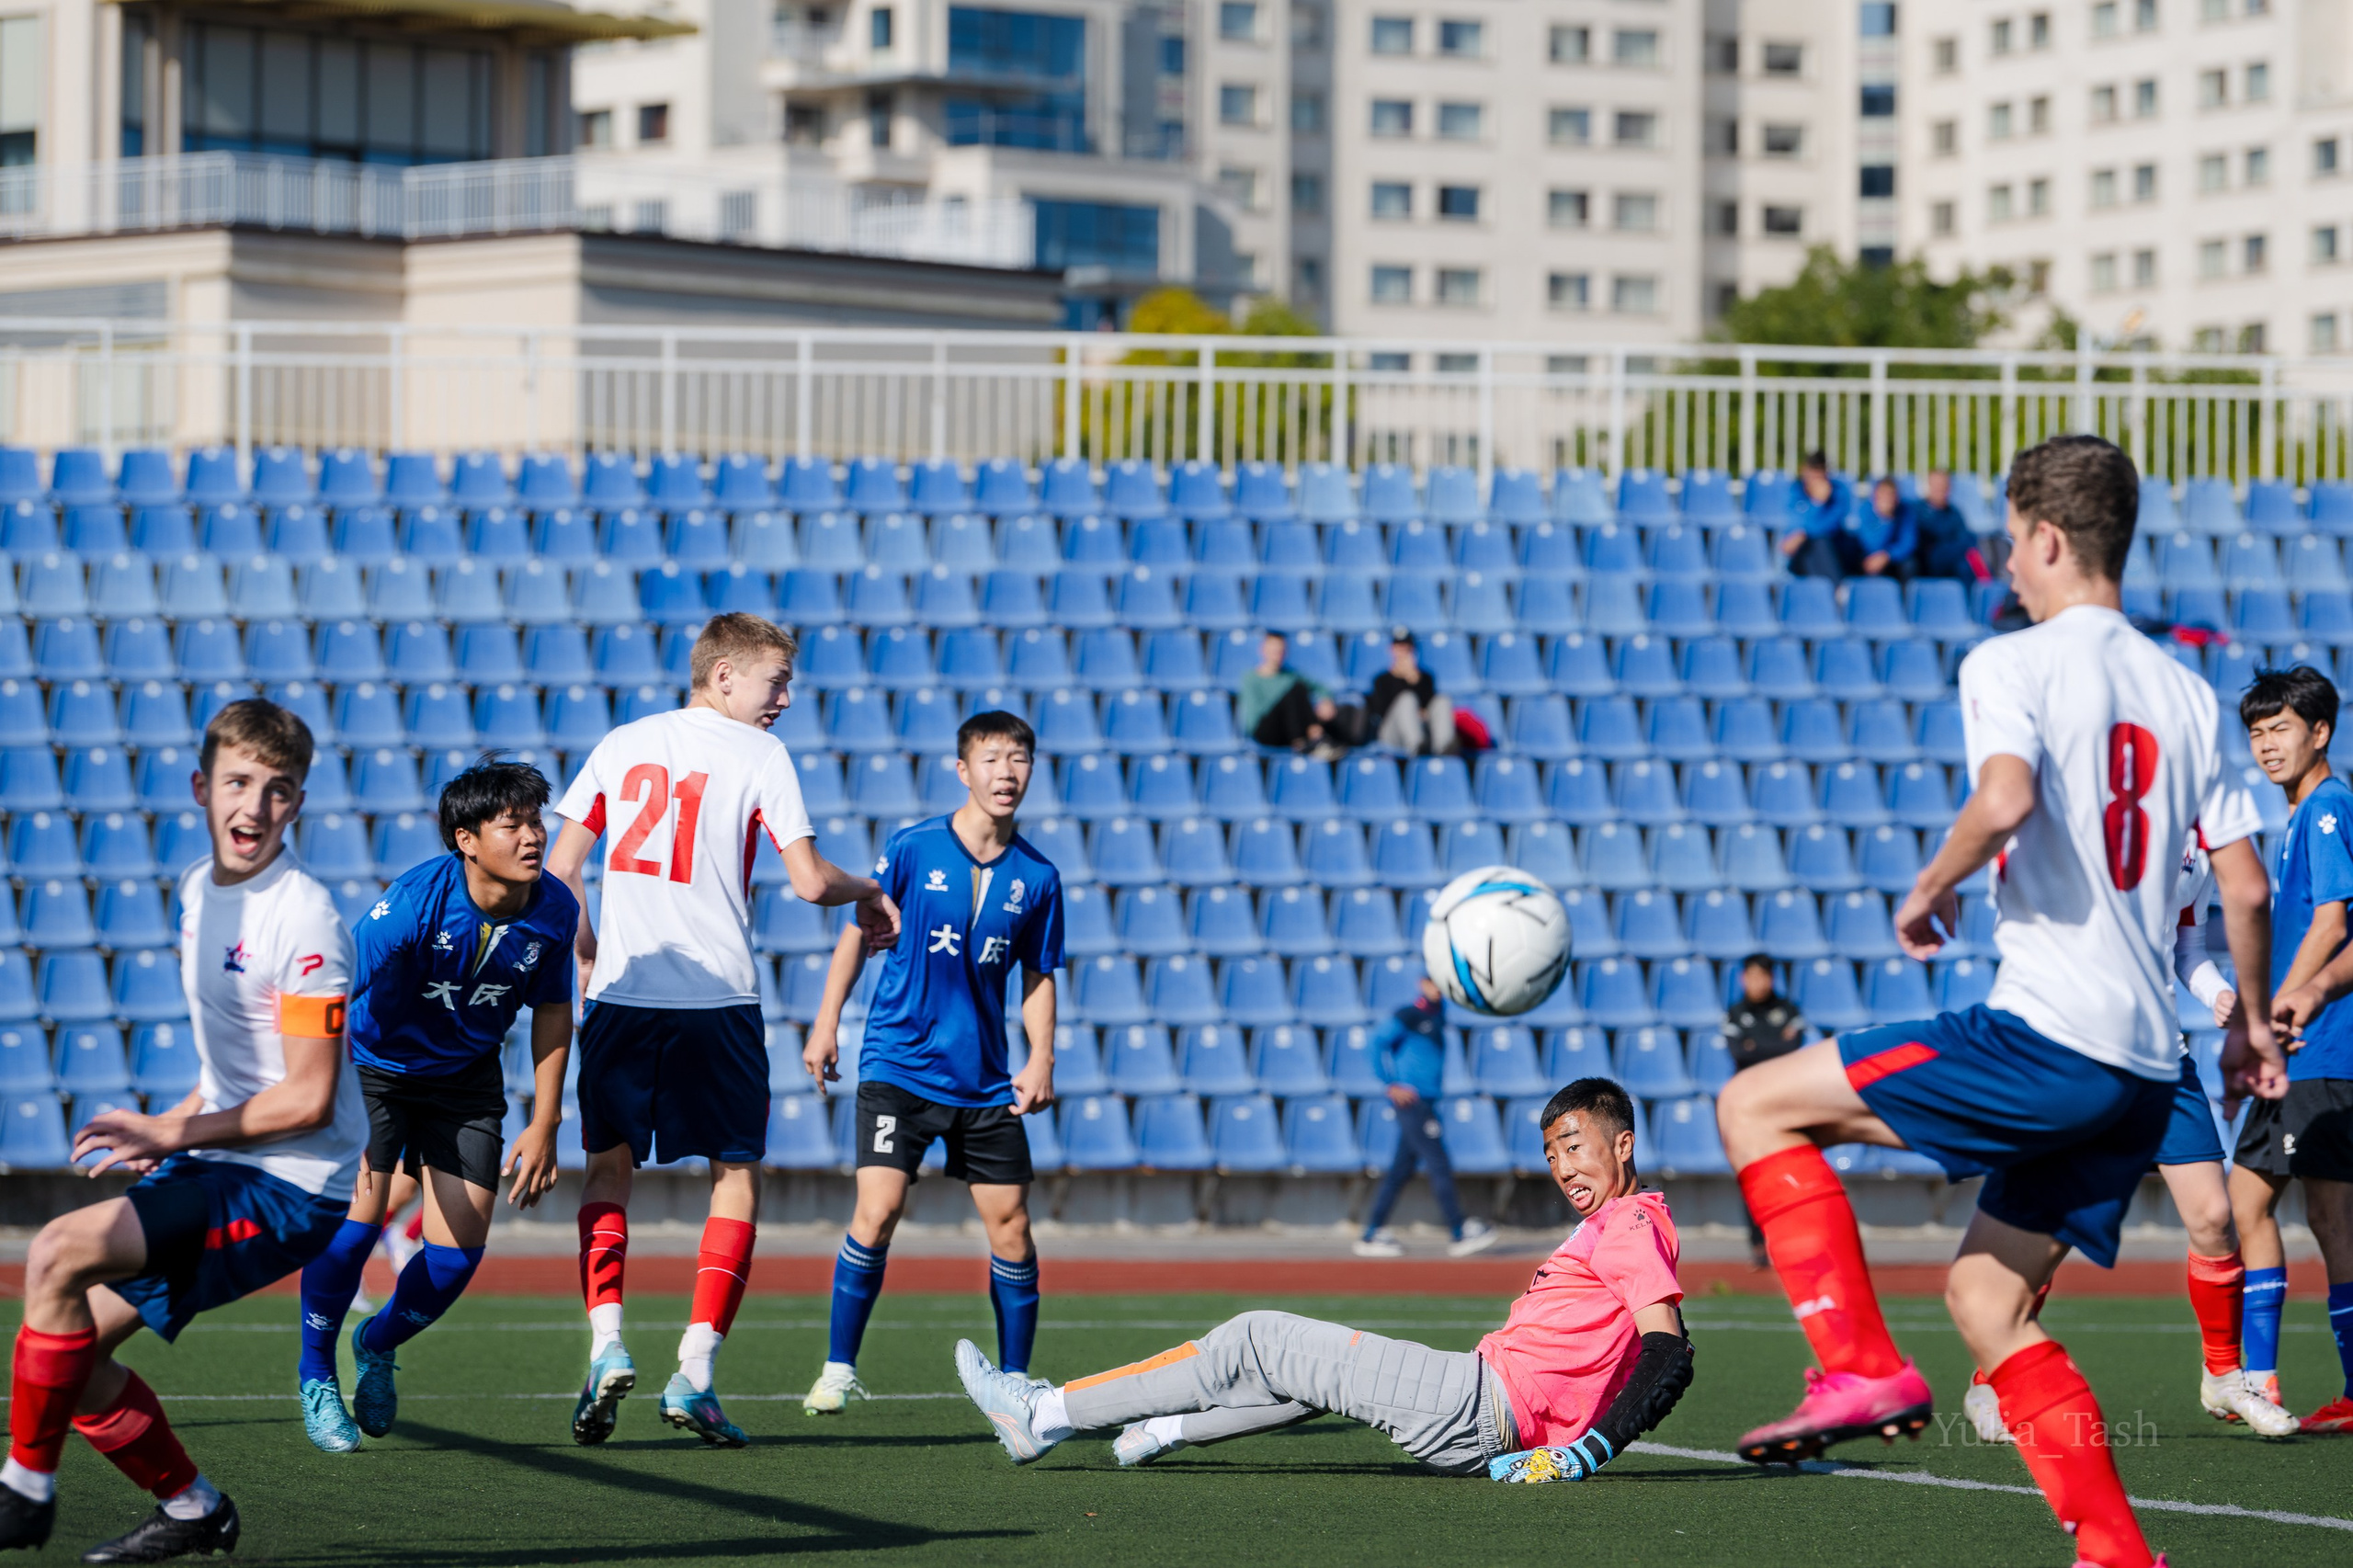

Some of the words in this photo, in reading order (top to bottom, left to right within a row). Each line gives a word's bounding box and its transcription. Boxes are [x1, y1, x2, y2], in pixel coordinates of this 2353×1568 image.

[608, 763, 709, 884] 21
[2104, 721, 2159, 892] 8
[928, 924, 1010, 964] 大庆
[873, 1114, 896, 1154] 2
[1628, 1219, 1654, 1232] KELM
